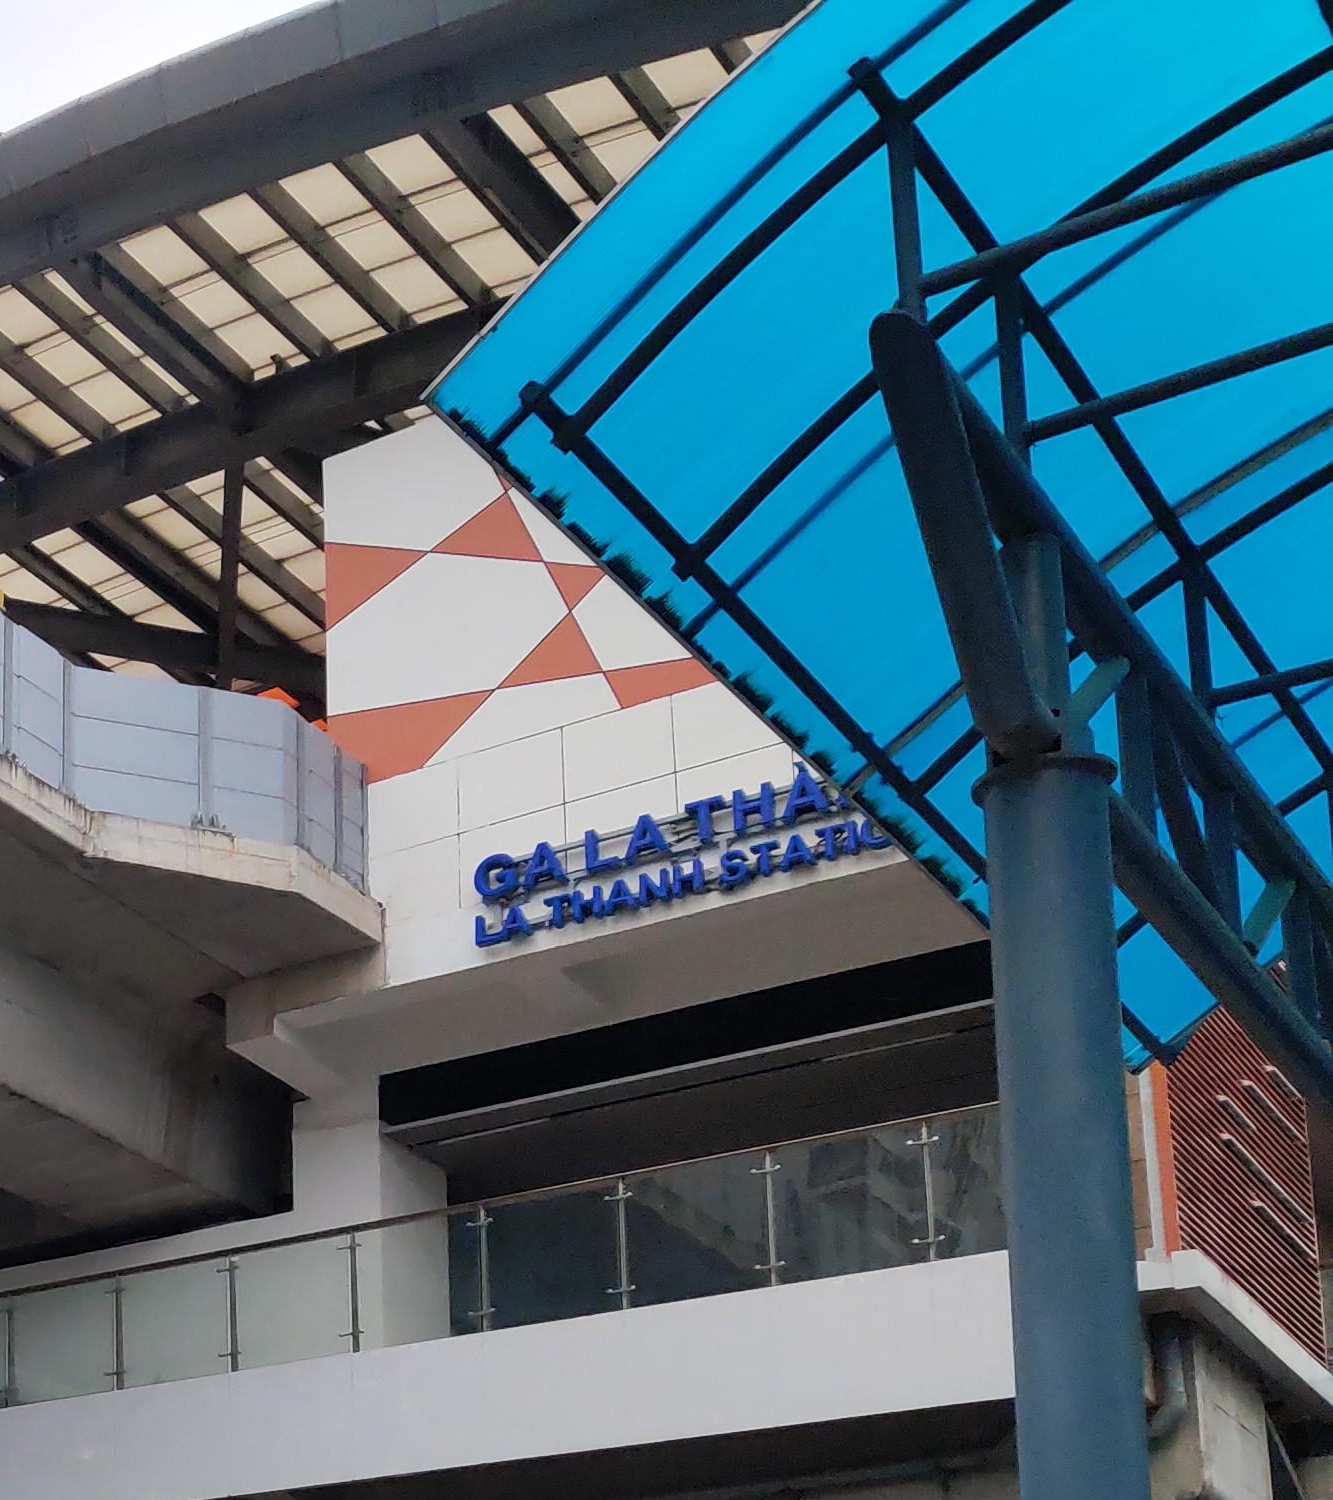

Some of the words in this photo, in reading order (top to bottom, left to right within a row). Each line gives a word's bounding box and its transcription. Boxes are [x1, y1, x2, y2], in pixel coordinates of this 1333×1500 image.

[474, 840, 571, 899] GA
[584, 813, 671, 874] LA
[684, 761, 848, 848] THÀ
[475, 906, 534, 948] LA
[543, 857, 706, 929] THANH
